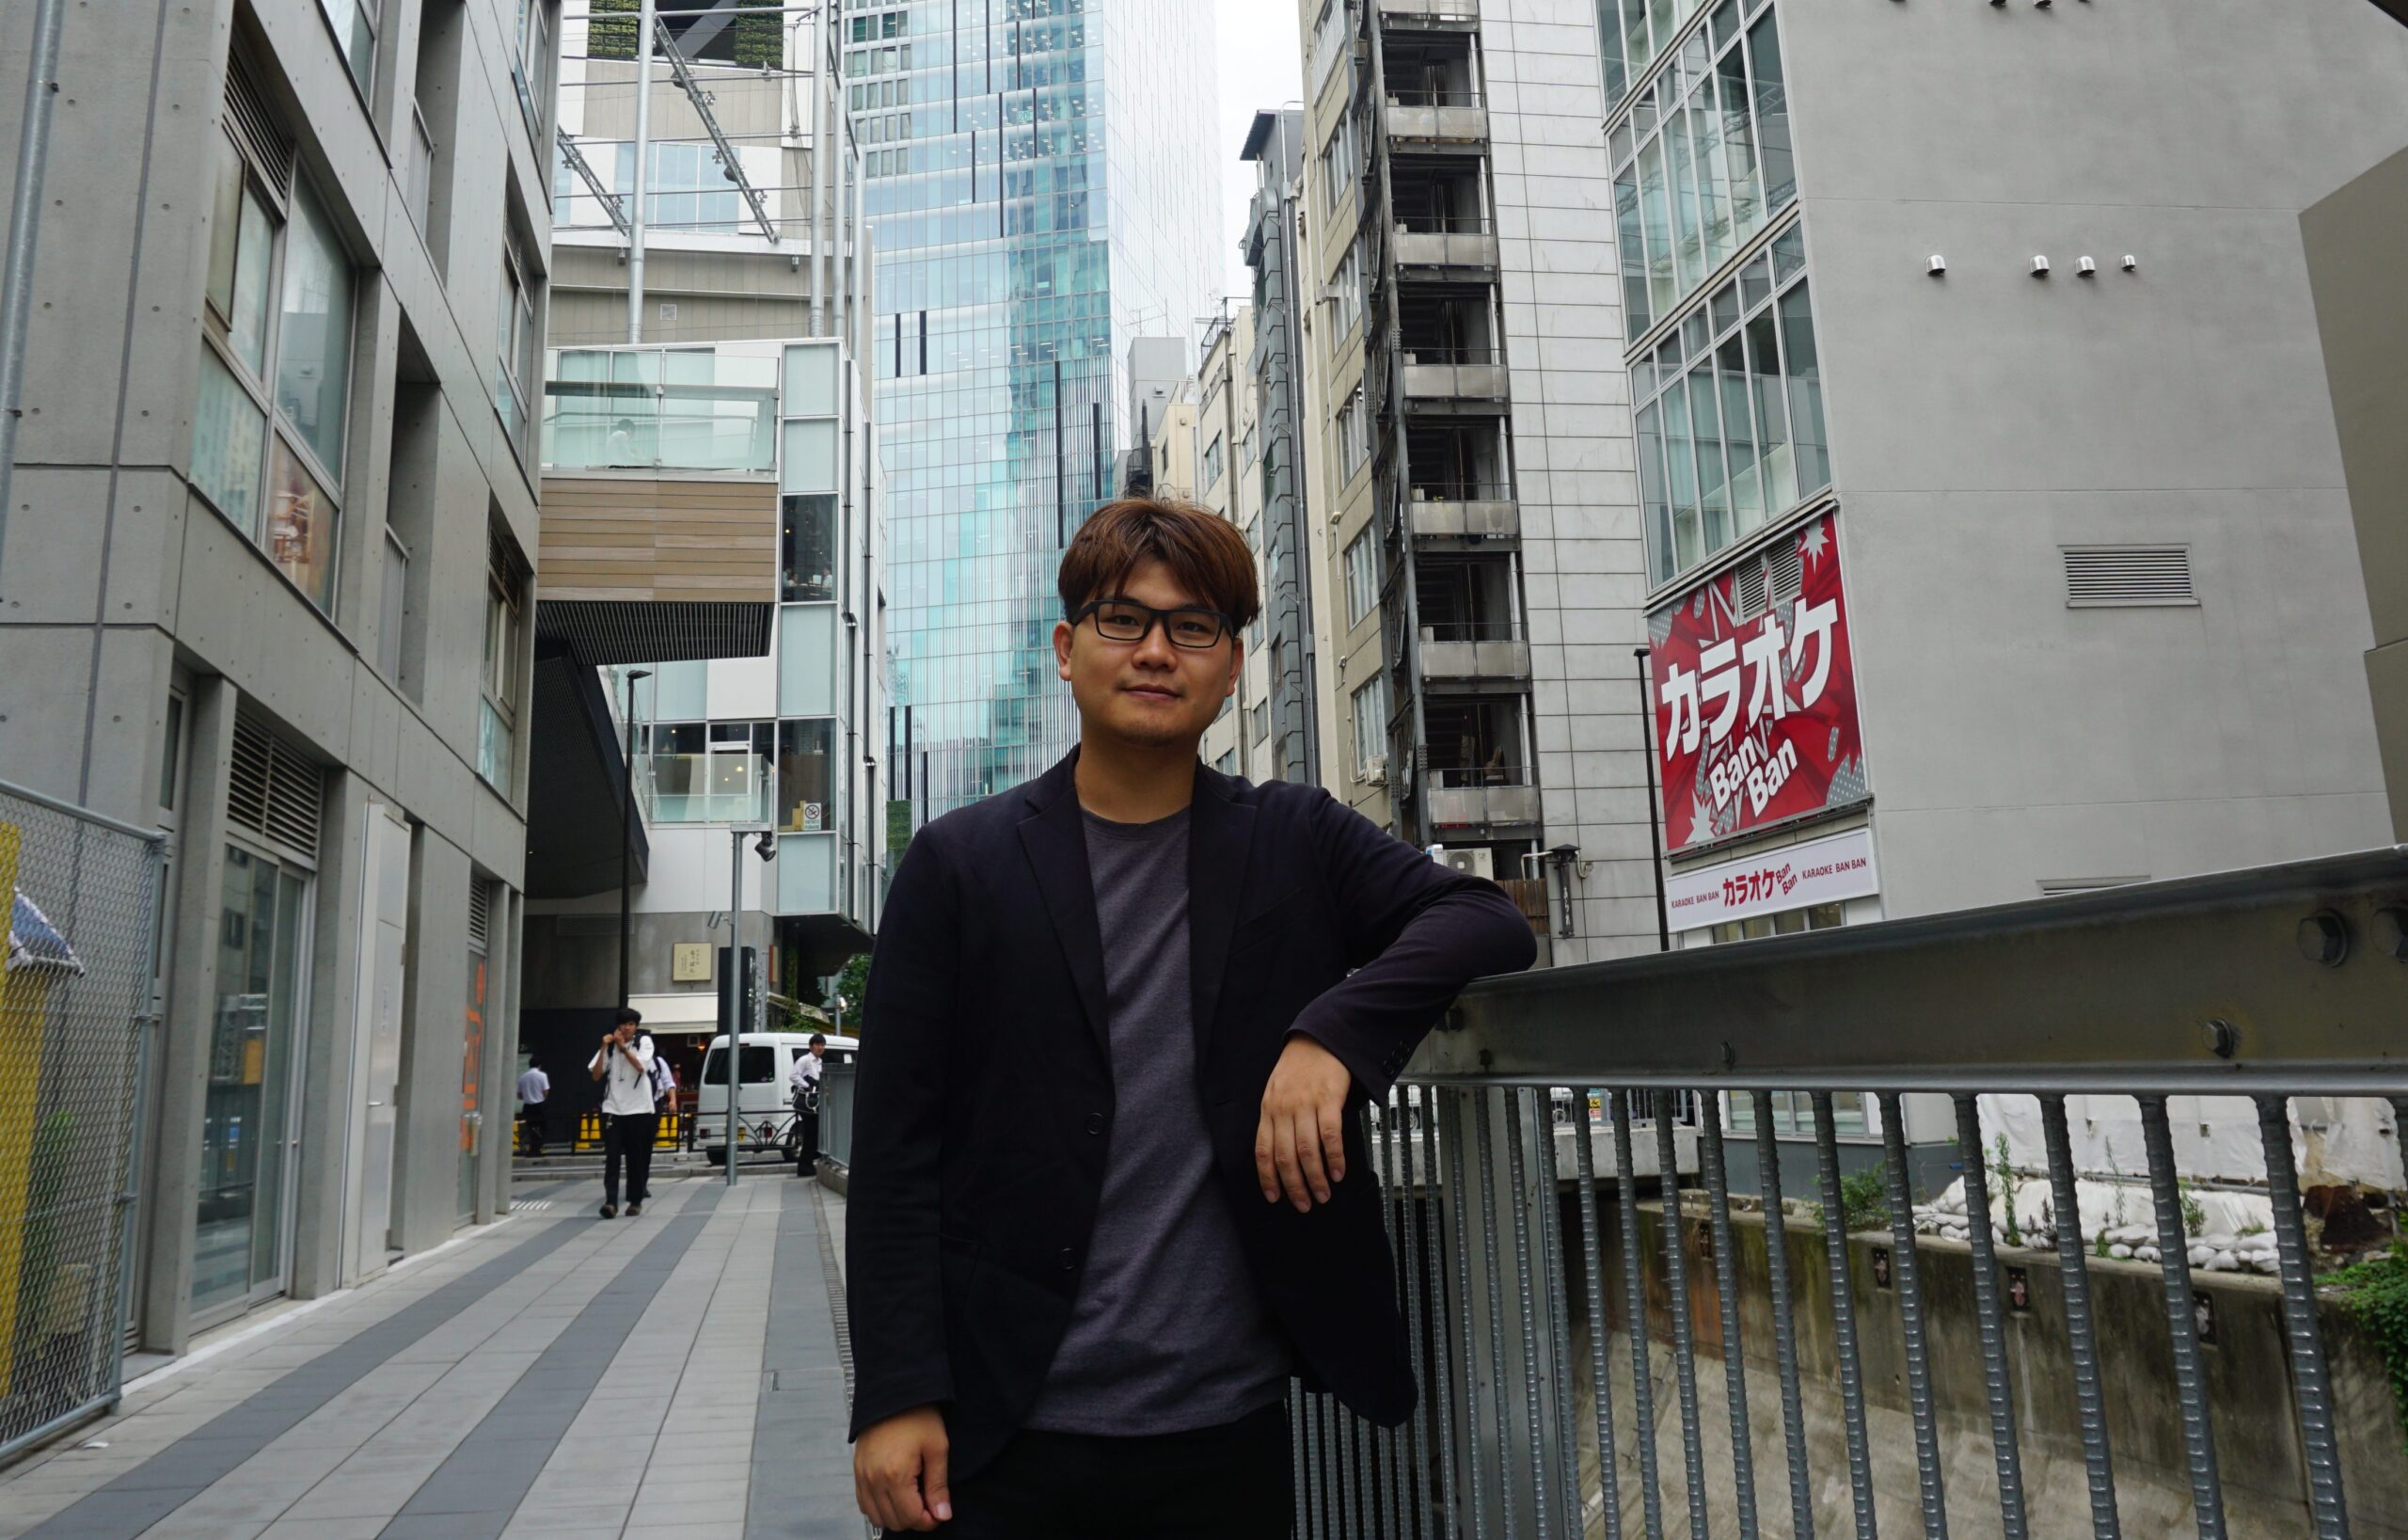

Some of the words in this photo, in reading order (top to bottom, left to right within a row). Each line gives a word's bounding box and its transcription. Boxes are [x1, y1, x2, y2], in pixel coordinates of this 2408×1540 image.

[1661, 597, 1838, 762] カラオケ
[1710, 736, 1757, 812] Ban
[1747, 738, 1798, 818] Ban
[1775, 863, 1791, 884] Ban
[1801, 865, 1833, 880] KARAOKE
[1835, 861, 1850, 873] BAN
[1851, 857, 1867, 869] BAN
[1671, 897, 1695, 908] KARAOKE
[1696, 894, 1707, 903] BAN
[1708, 891, 1719, 900] BAN
[1722, 868, 1775, 907] カラオケ
[1782, 874, 1798, 896] Ban
